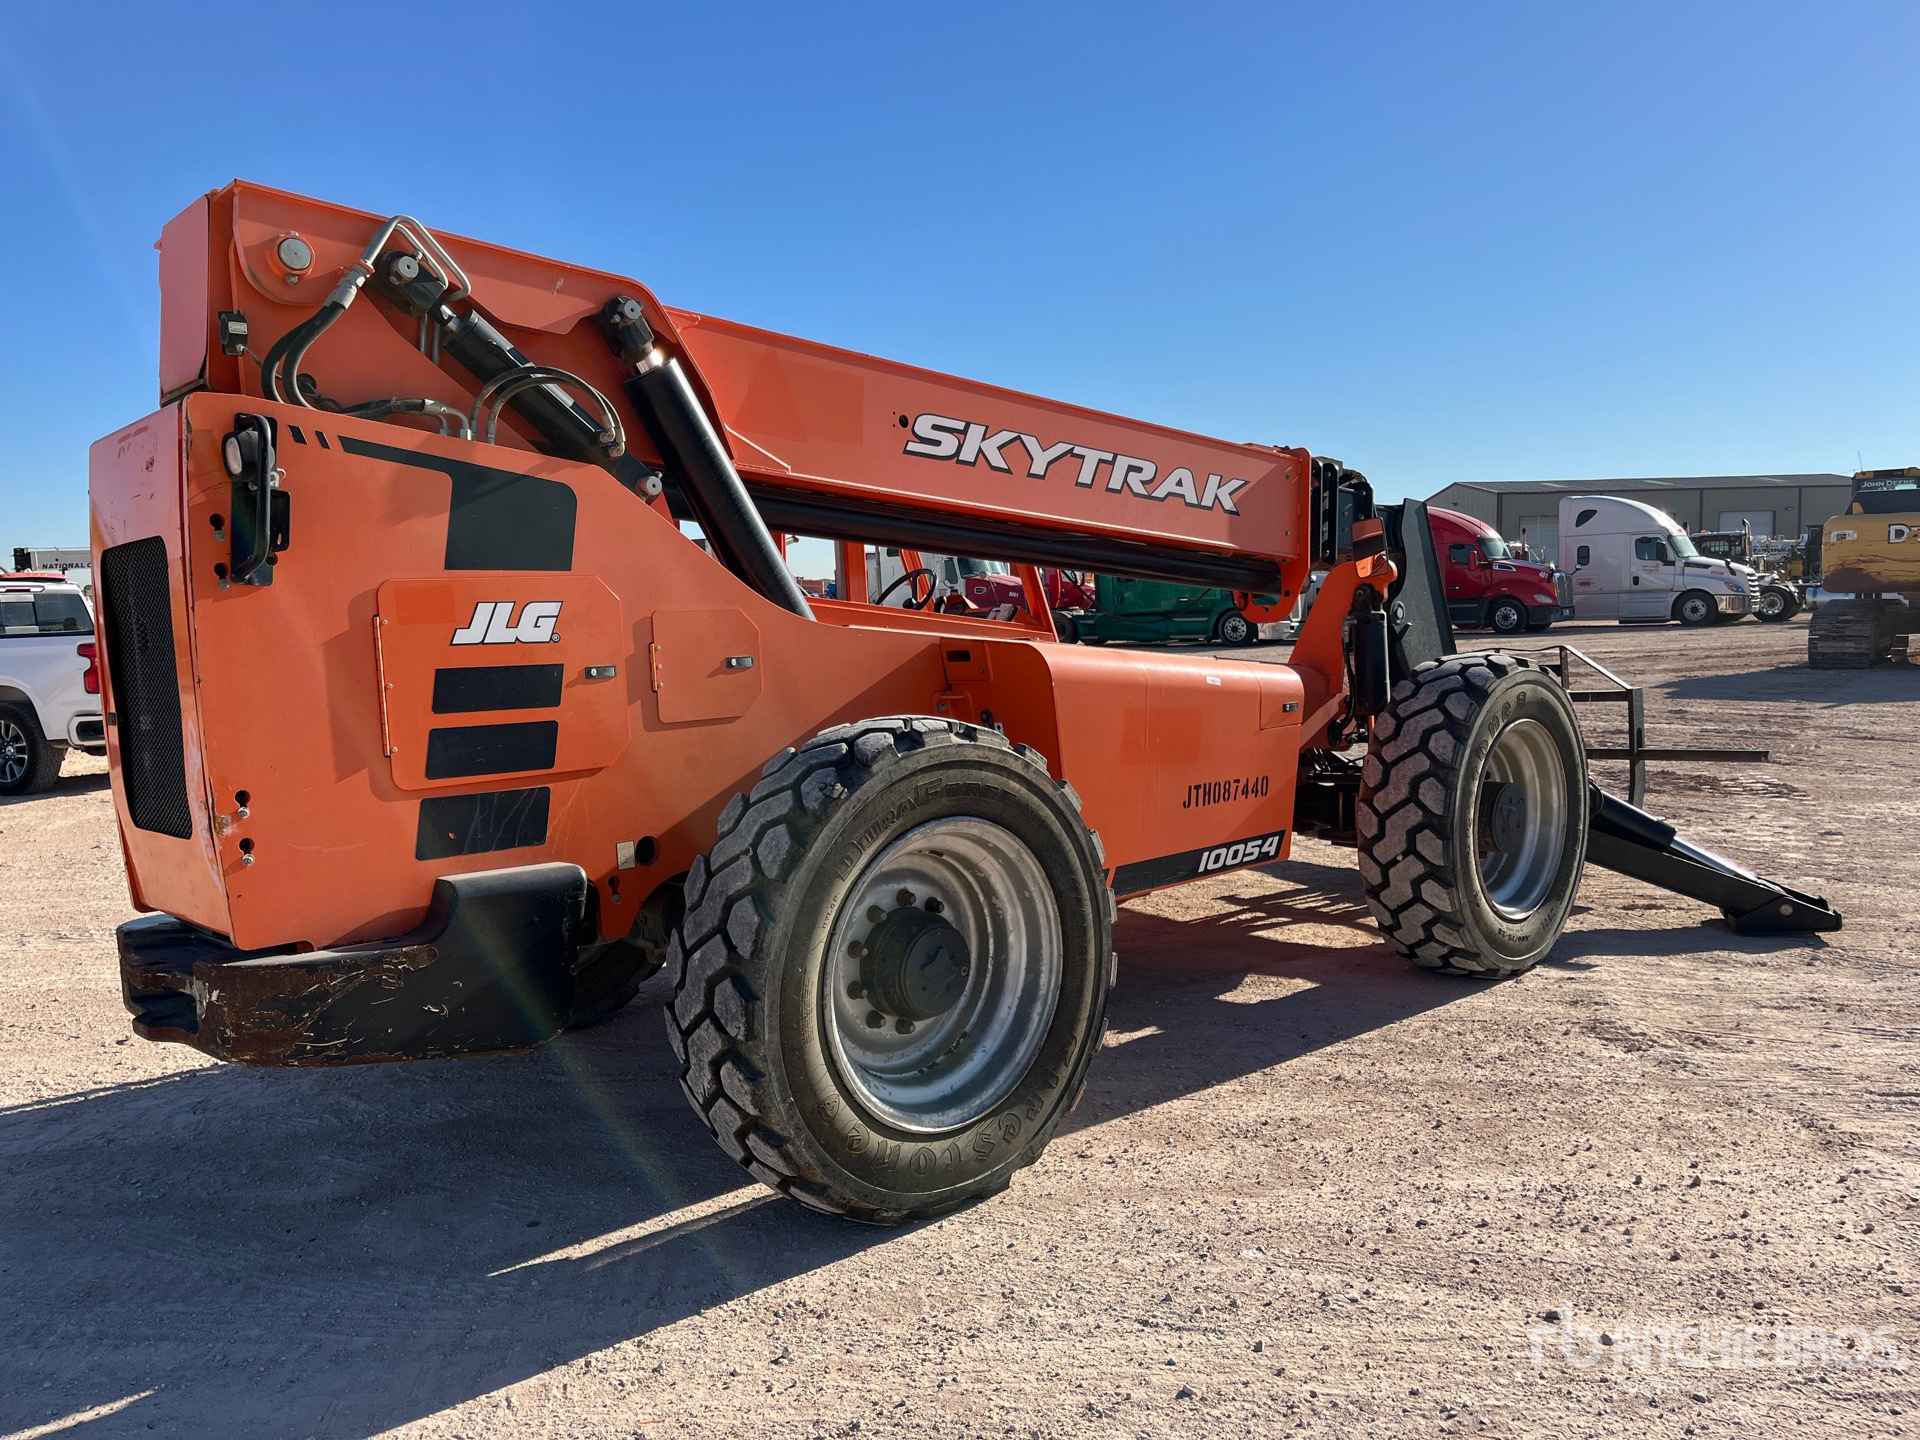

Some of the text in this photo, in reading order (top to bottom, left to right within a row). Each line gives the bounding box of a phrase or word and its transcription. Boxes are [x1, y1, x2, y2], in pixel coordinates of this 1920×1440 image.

[903, 413, 1250, 516] SKYTRAK
[42, 562, 85, 570] NATIONAL
[450, 601, 564, 646] JLG
[1183, 775, 1269, 809] JTH087440
[1198, 835, 1279, 872] 10054
